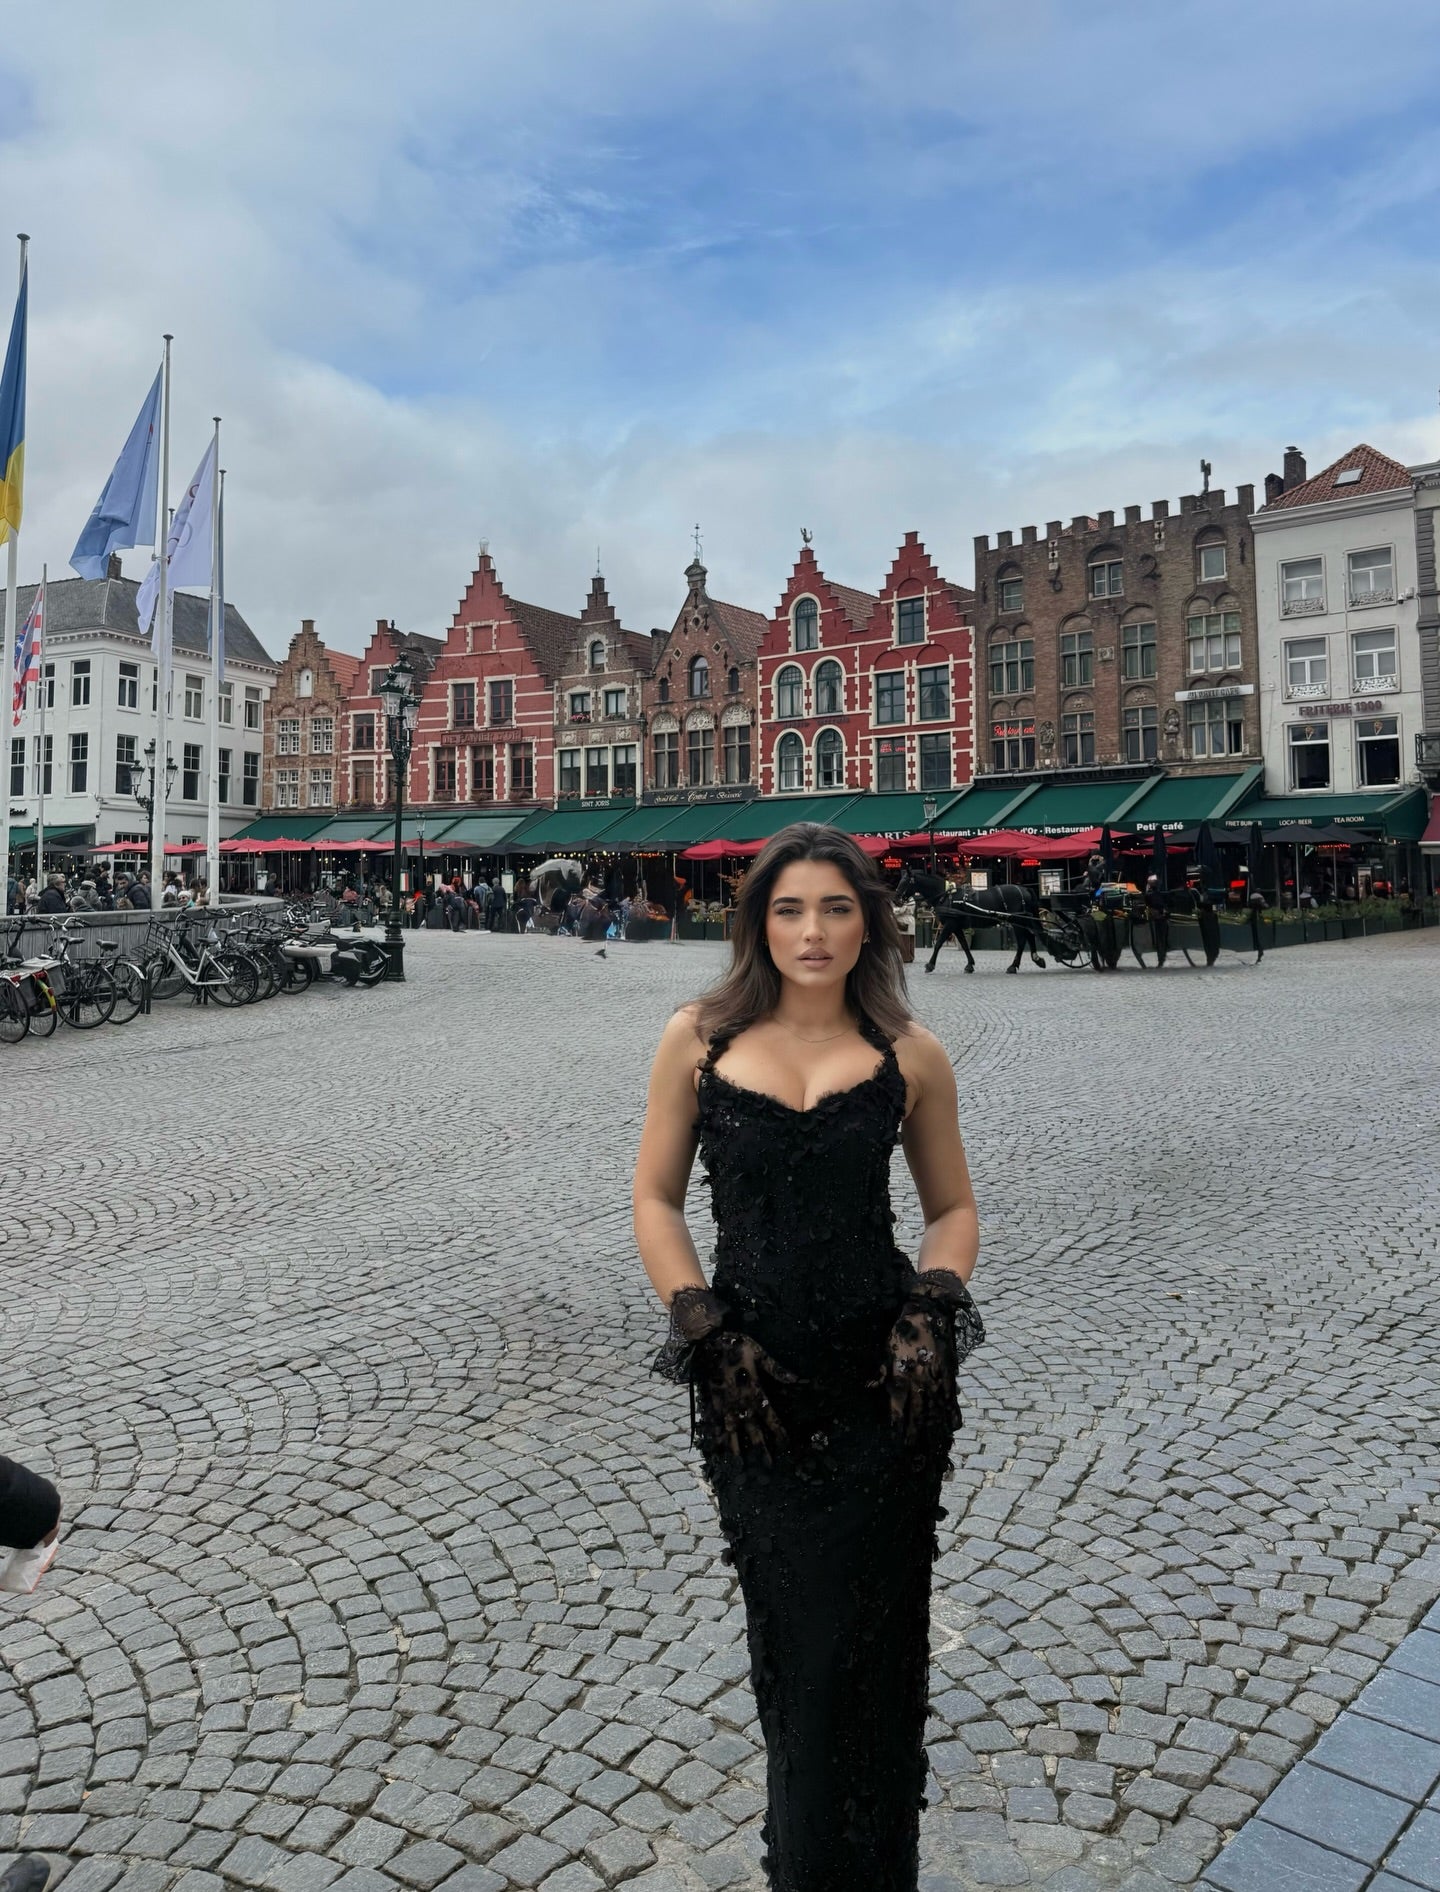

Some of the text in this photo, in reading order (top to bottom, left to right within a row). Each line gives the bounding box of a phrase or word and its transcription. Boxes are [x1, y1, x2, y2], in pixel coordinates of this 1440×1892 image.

[1299, 703, 1353, 716] FRITERIE
[977, 828, 988, 837] La
[1045, 826, 1095, 835] Restaurant
[1162, 821, 1184, 831] café
